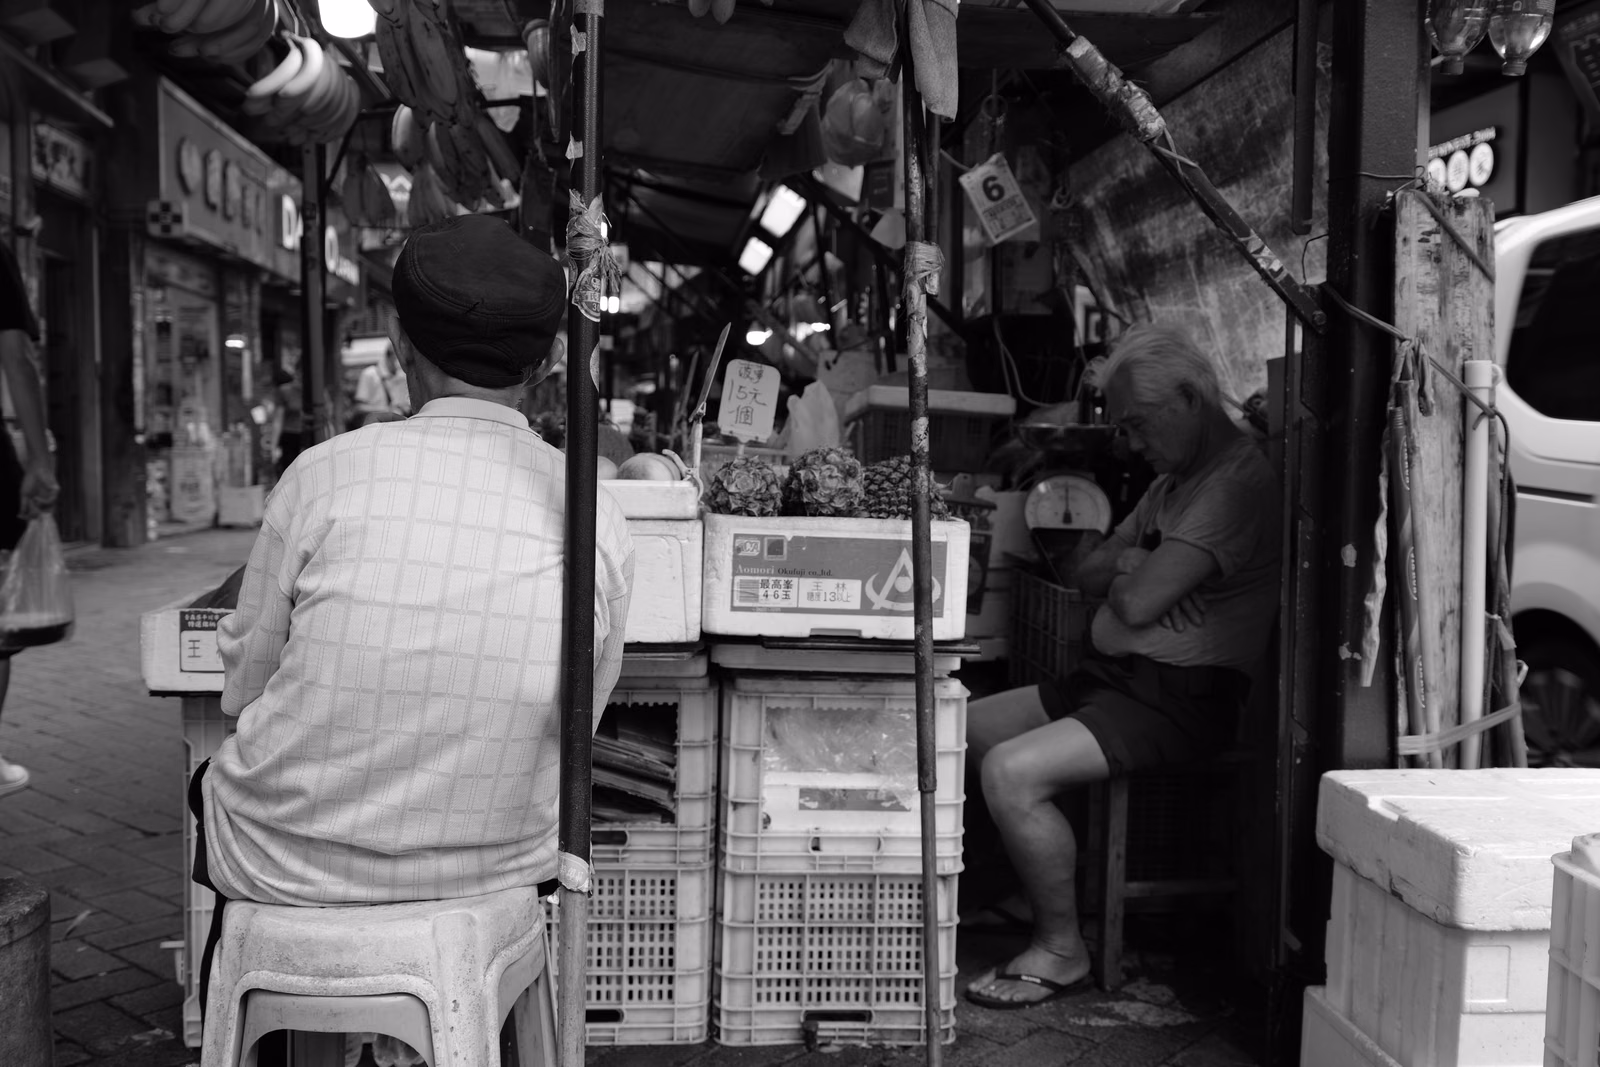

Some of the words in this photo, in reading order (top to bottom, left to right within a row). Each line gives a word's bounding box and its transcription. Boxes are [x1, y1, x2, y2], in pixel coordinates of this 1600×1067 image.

[982, 175, 1005, 202] 6
[736, 564, 775, 575] Aomori
[777, 567, 806, 578] Okufuji
